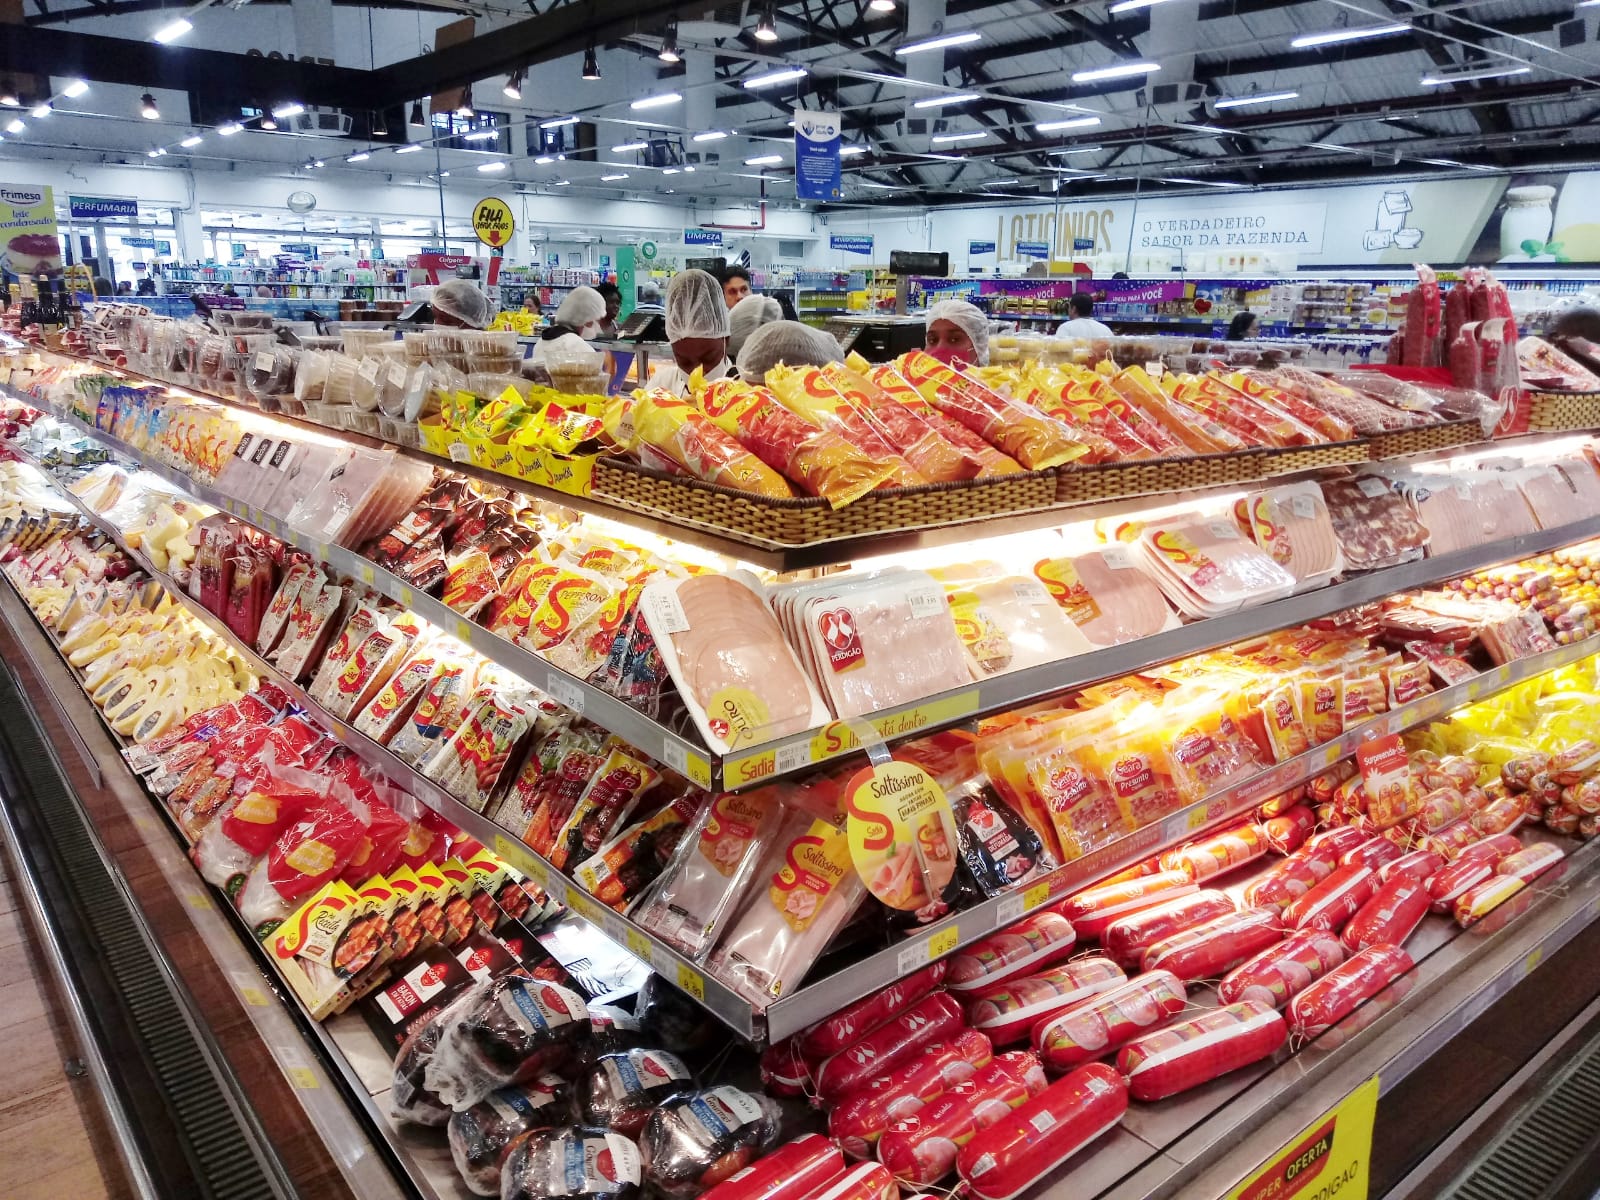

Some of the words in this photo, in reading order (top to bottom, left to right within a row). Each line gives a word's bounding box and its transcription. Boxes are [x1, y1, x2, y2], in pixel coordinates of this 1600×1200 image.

[1, 189, 41, 200] Frimesa
[72, 201, 137, 213] PERFUMARIA
[479, 206, 503, 221] FILA
[0, 217, 52, 229] condensado
[1143, 222, 1152, 232] O
[1159, 216, 1266, 231] VERDADEIRO
[687, 232, 721, 240] LIMPEZA
[1142, 235, 1192, 247] SABOR
[1200, 233, 1220, 245] DA
[1226, 231, 1310, 244] FAZENDA
[1142, 287, 1163, 300] VOCÊ
[831, 648, 861, 662] PERDIGÃO
[723, 700, 753, 739] OURO
[899, 710, 927, 732] dentro
[741, 757, 775, 781] Sadia
[1117, 760, 1141, 775] Seara
[1120, 772, 1149, 791] Presunto
[397, 985, 417, 1006] BACON
[706, 1096, 731, 1124] Gourmet
[691, 1102, 722, 1138] DEFUMADO
[1286, 1138, 1328, 1180] OFERTA
